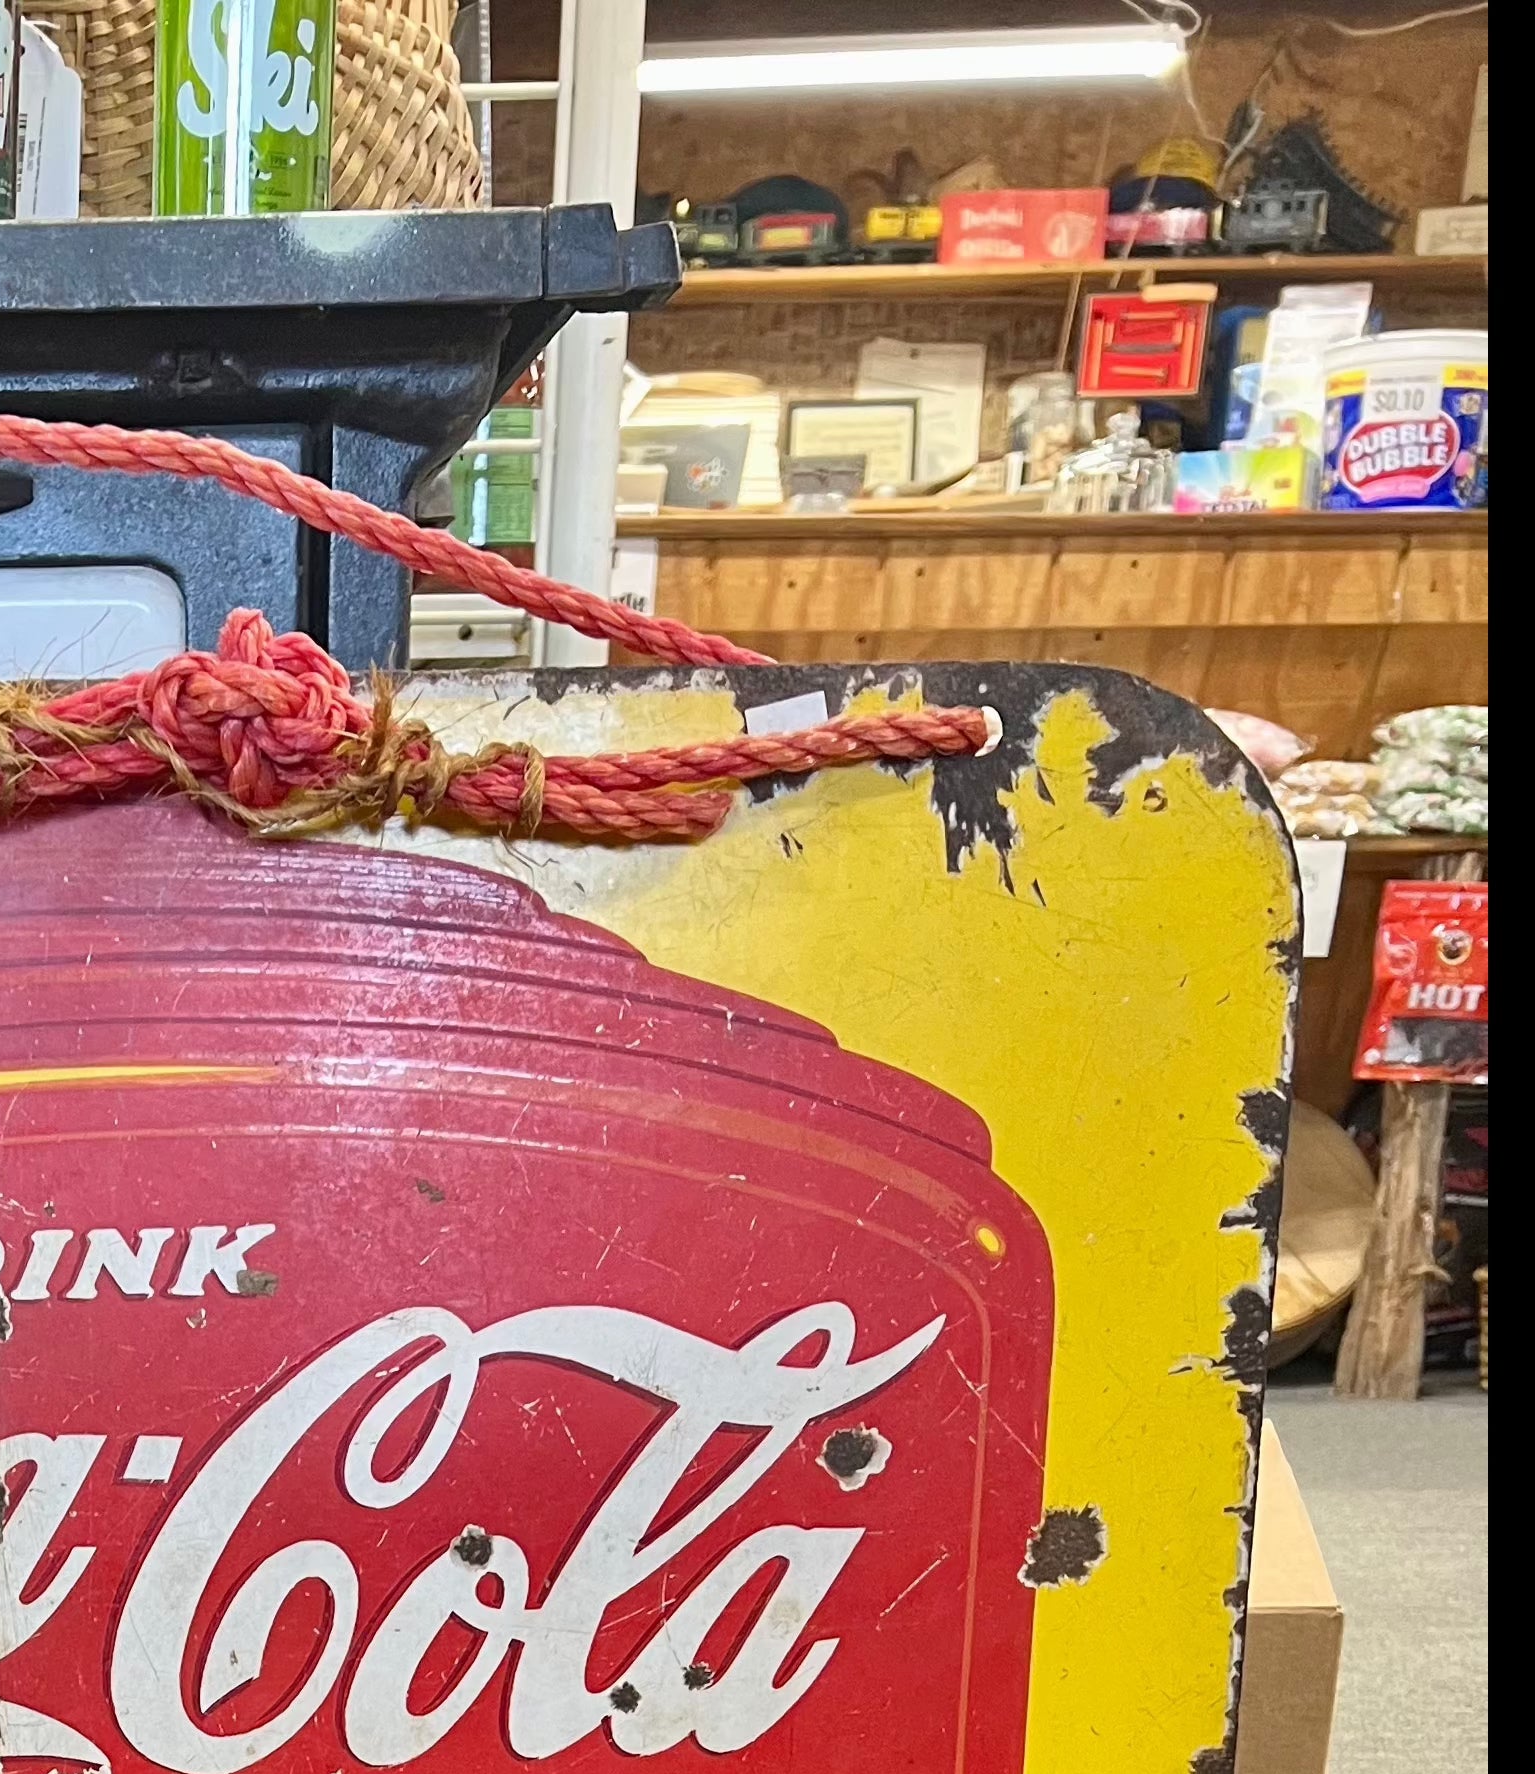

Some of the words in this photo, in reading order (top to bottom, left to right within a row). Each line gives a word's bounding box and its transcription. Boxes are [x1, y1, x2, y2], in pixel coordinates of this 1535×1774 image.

[177, 0, 319, 137] Ski
[1375, 388, 1425, 413] $0.10
[1348, 421, 1448, 461] DUBBLE
[1351, 444, 1449, 482] BUBBLE
[1407, 982, 1485, 1012] HOT
